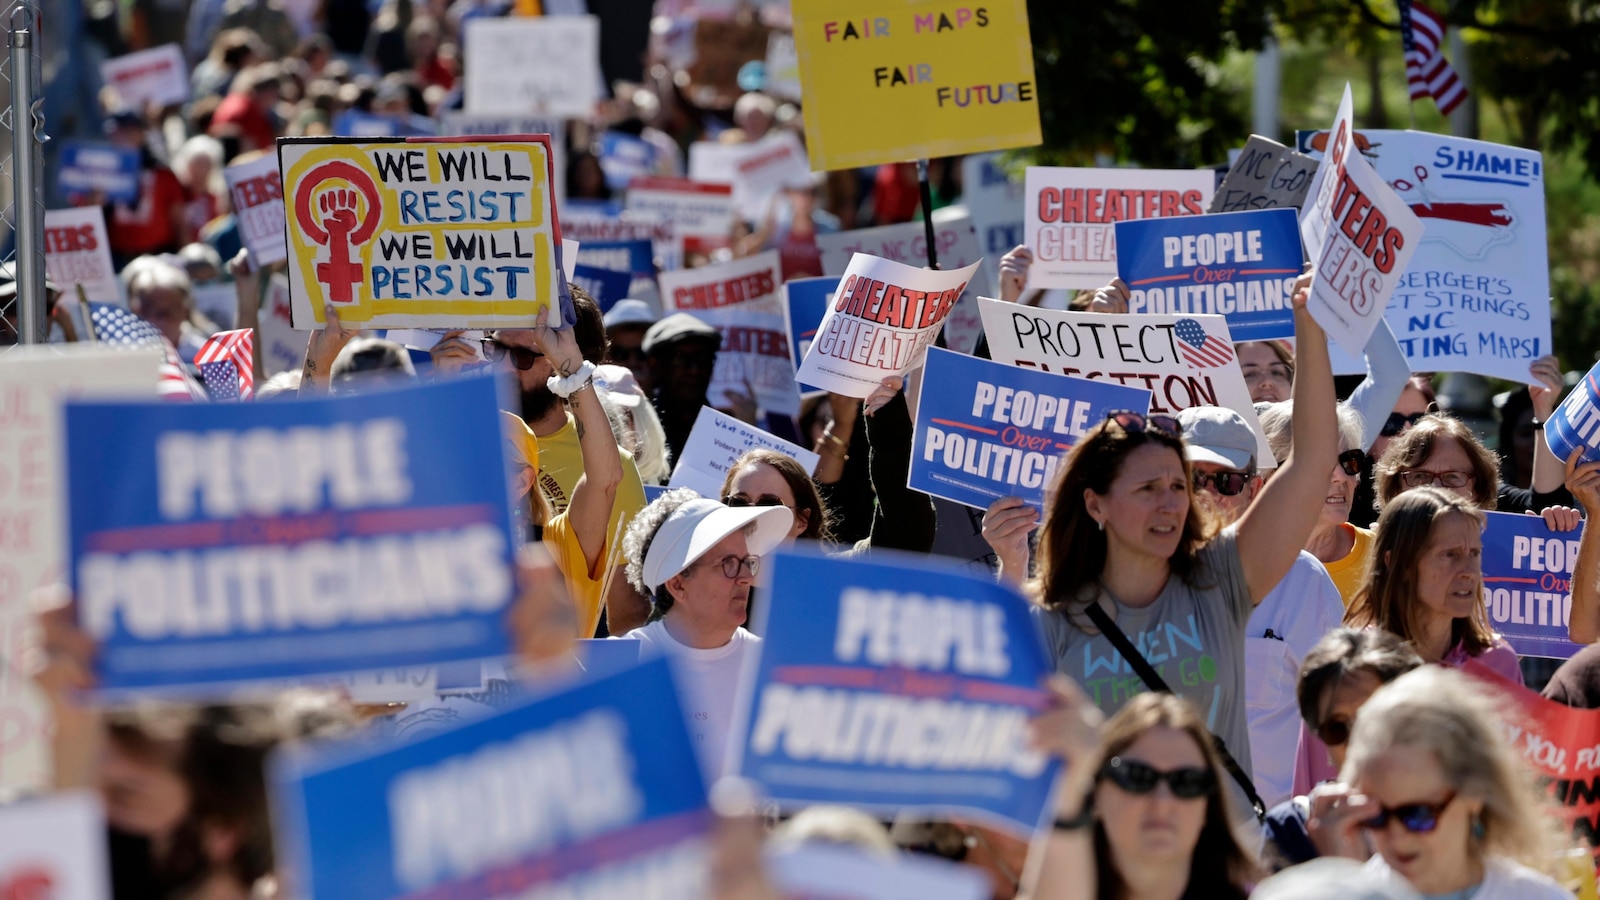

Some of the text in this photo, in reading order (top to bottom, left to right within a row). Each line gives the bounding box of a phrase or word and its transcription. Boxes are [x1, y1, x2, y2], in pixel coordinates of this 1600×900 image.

[824, 8, 989, 42] FAIR MAPS
[874, 64, 933, 87] FAIR
[937, 82, 1033, 108] FUTURE
[374, 150, 530, 182] WE WILL
[1236, 149, 1272, 180] NC
[1433, 146, 1540, 181] SHAME!
[401, 190, 525, 224] RESIST
[1038, 187, 1203, 223] CHEATERS
[45, 224, 98, 255] TERS
[379, 233, 432, 261] WE
[445, 231, 533, 261] WILL
[1037, 225, 1116, 262] CHEA
[1163, 230, 1263, 268] PEOPLE
[372, 264, 530, 299] PERSIST
[1193, 266, 1236, 283] Over
[834, 274, 967, 330] CHEATERS
[1129, 277, 1297, 315] POLITICIANS
[1424, 291, 1530, 321] STRINGS
[1012, 312, 1181, 364] PROTECT
[1408, 311, 1457, 332] NC
[972, 381, 1092, 437] PEOPLE
[714, 438, 737, 453] Voters
[1001, 426, 1052, 451] Over
[156, 416, 413, 520] PEOPLE
[709, 460, 723, 471] Not
[924, 426, 1057, 490] POLITICI
[540, 474, 567, 501] FOREST
[1513, 535, 1582, 574] PEOP
[76, 523, 513, 642] POLITICIANS
[1541, 573, 1571, 593] Ove
[834, 586, 1011, 678] PEOPLE
[1179, 655, 1217, 686] GO
